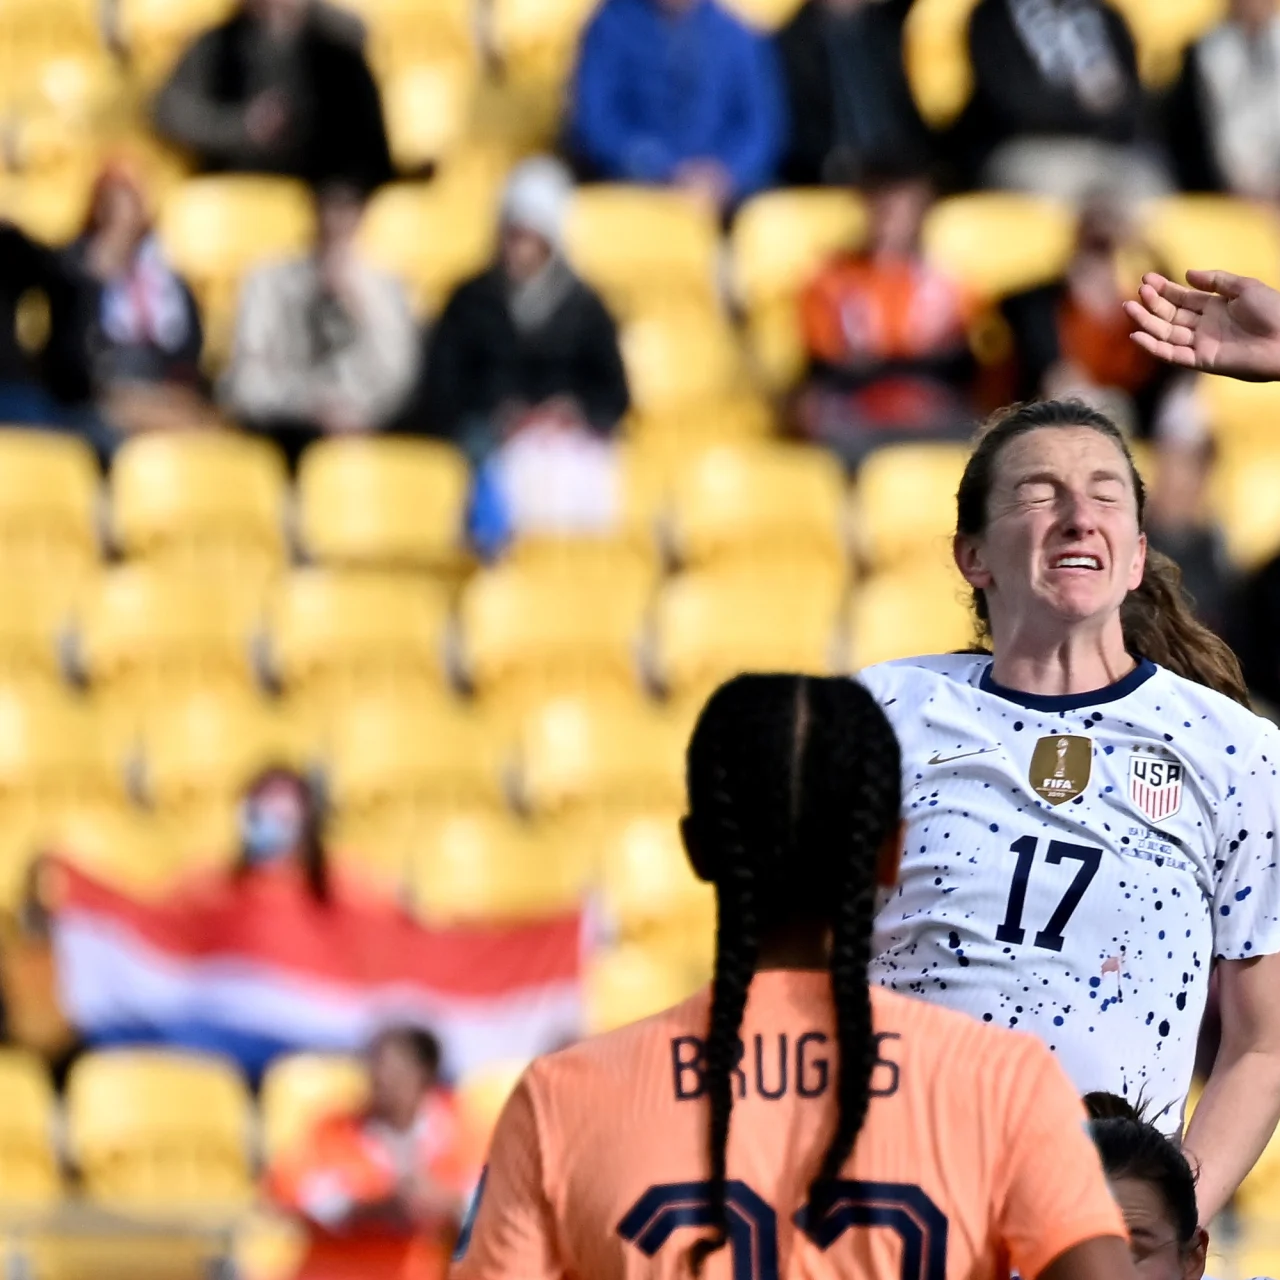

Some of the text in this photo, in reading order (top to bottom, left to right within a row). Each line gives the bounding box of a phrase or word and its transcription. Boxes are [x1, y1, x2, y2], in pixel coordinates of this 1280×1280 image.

[1043, 778, 1072, 789] FIFA
[1134, 760, 1180, 787] USA
[995, 834, 1104, 953] 17
[670, 1032, 900, 1101] BUGS
